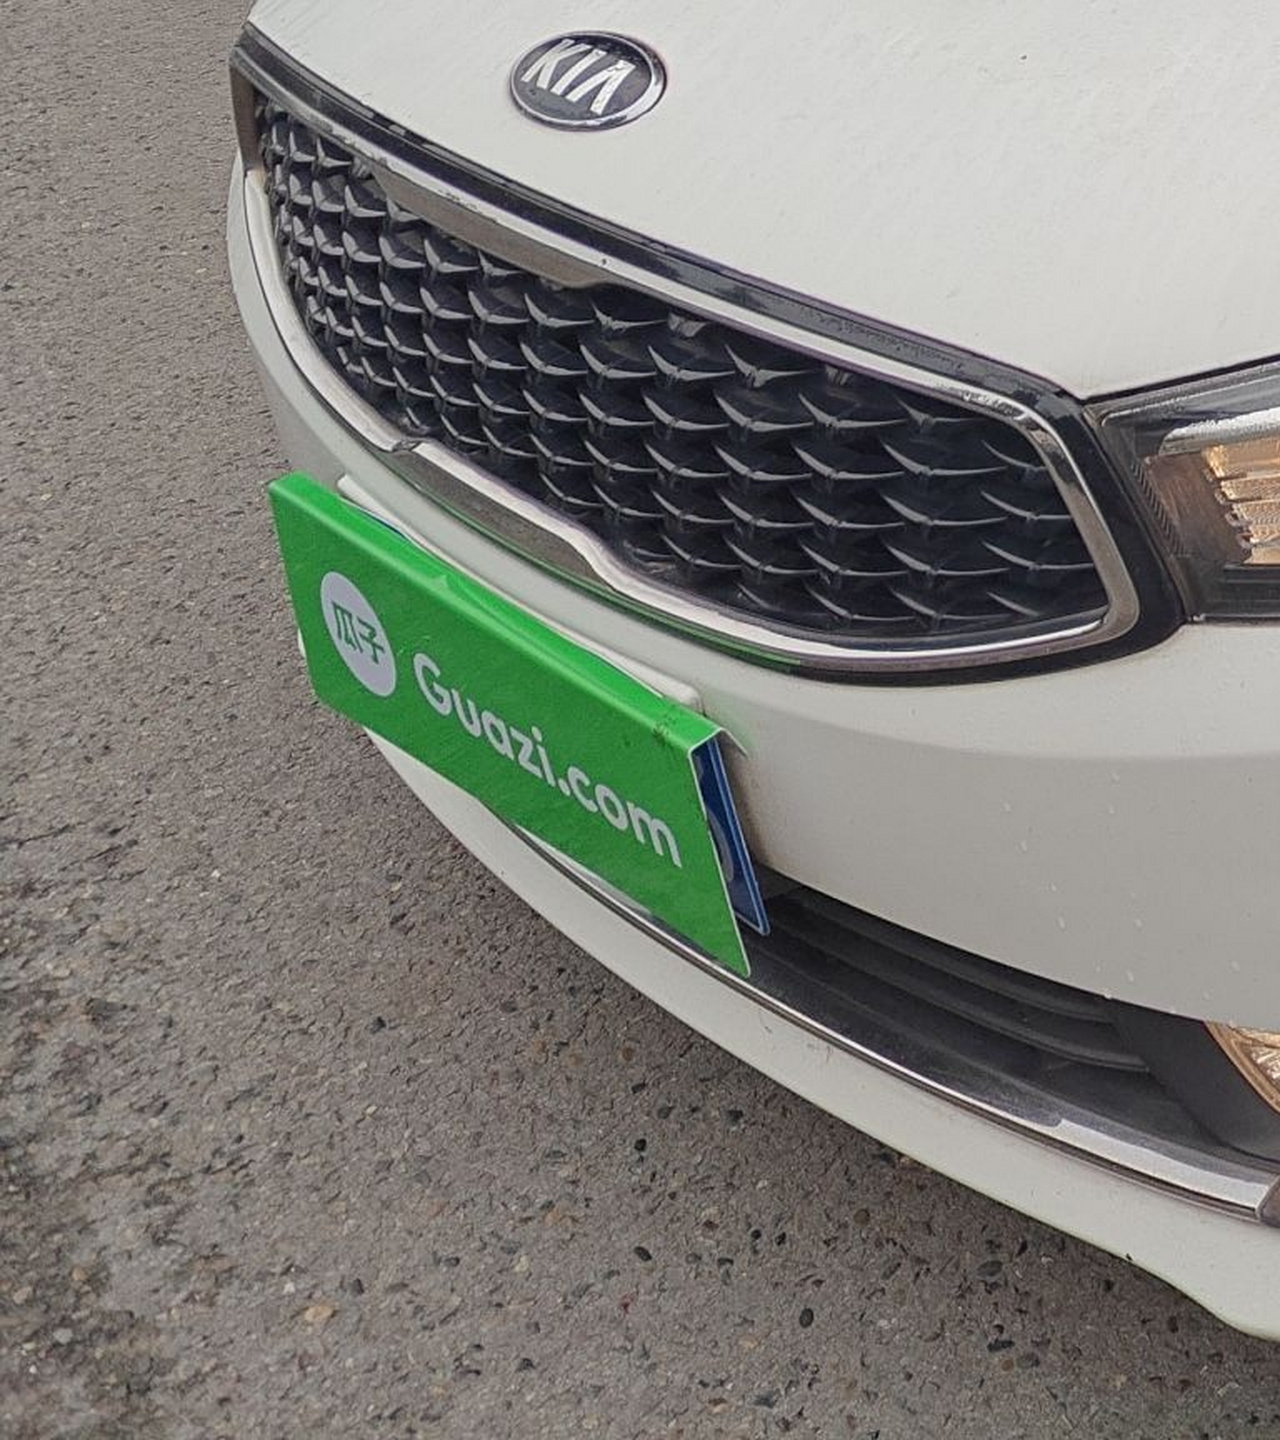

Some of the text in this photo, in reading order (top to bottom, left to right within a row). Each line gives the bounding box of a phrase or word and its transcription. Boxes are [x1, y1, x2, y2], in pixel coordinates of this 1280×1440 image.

[521, 38, 636, 116] KIA
[331, 601, 386, 665] 瓜子
[413, 652, 682, 868] Guazi.com
